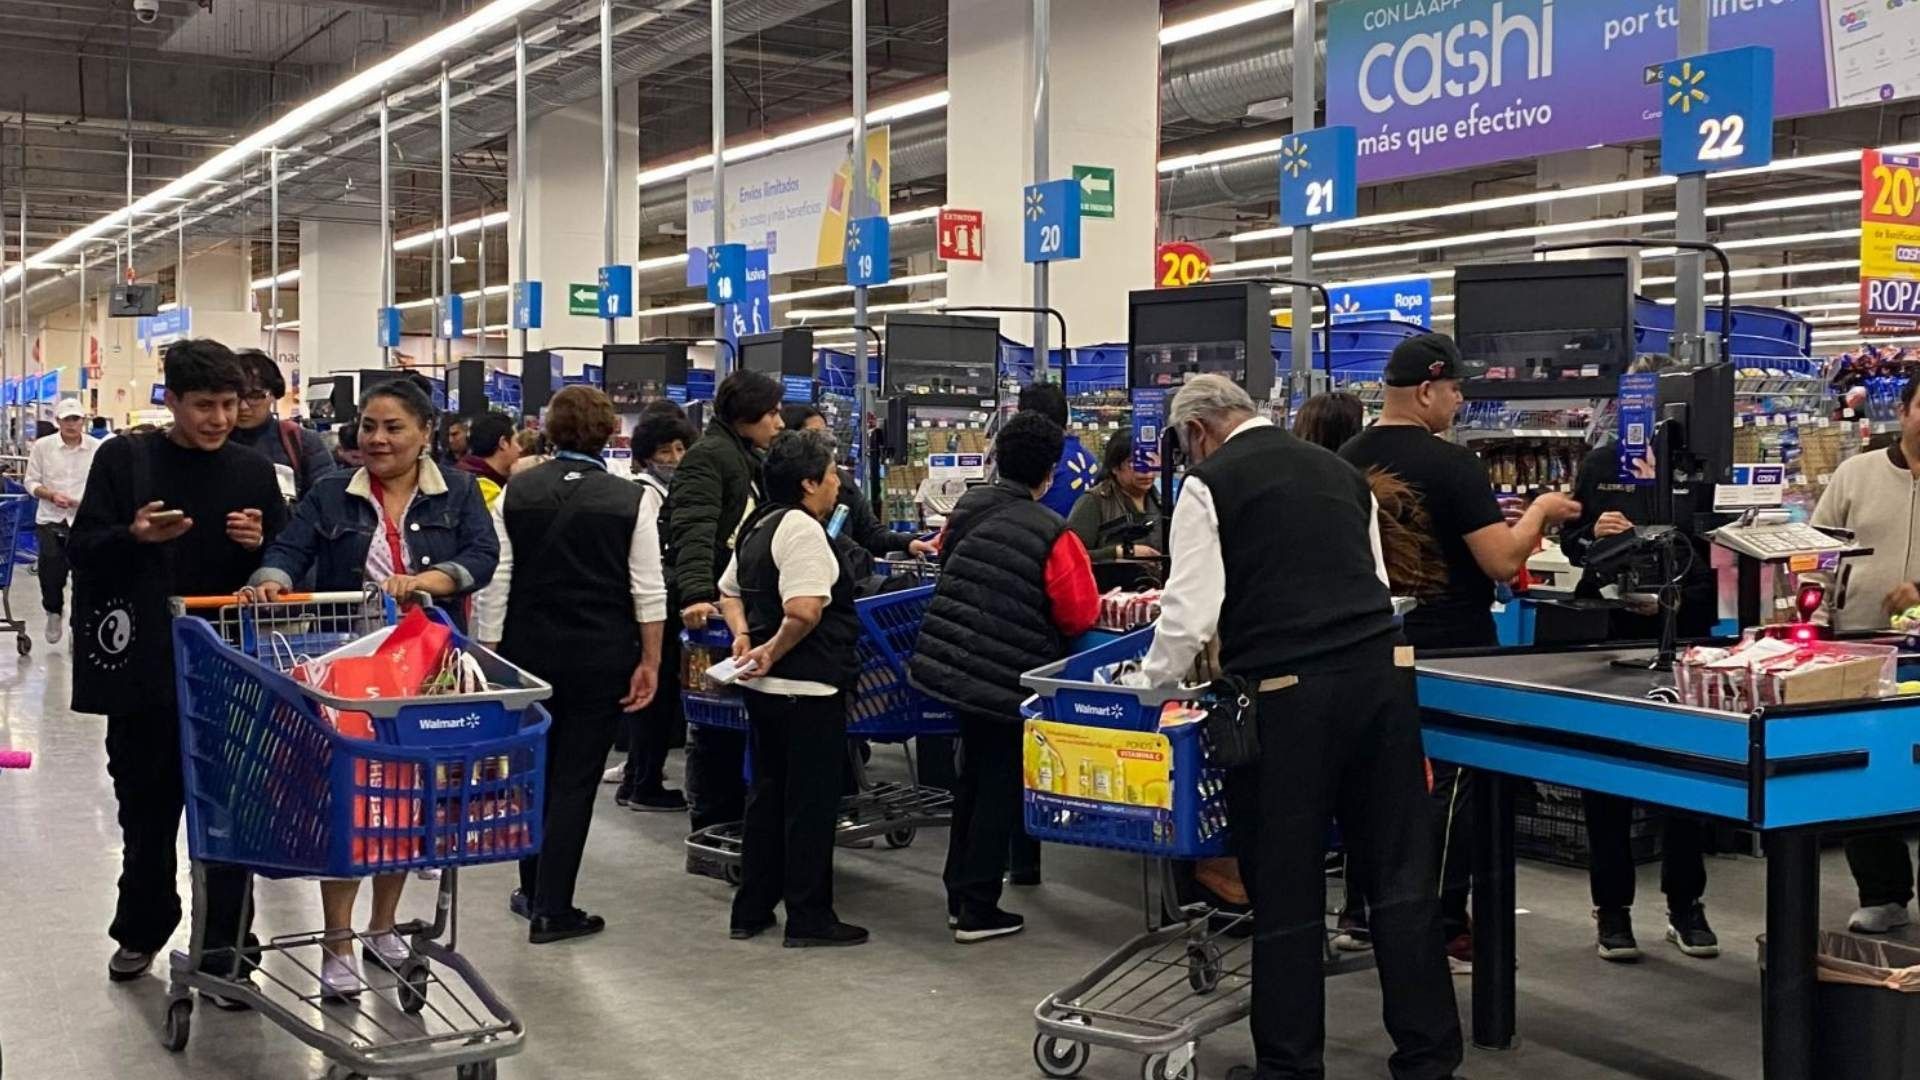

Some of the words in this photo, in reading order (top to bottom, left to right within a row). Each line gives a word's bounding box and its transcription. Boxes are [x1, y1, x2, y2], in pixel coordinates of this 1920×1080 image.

[1364, 3, 1399, 31] CON
[1404, 0, 1425, 20] LA
[1604, 12, 1649, 50] por
[1358, 0, 1553, 114] cashi
[1357, 124, 1401, 156] más
[1407, 123, 1448, 155] que
[1455, 98, 1552, 139] efectivo
[1697, 114, 1744, 160] 22
[1306, 179, 1333, 216] 21
[1040, 225, 1060, 252] 20
[858, 255, 872, 278] 19
[717, 277, 732, 299] 18
[607, 294, 619, 314] 17
[1394, 293, 1423, 310] Ropa
[520, 307, 529, 324] 16
[1074, 703, 1110, 716] Walmart
[419, 717, 464, 730] Walmart
